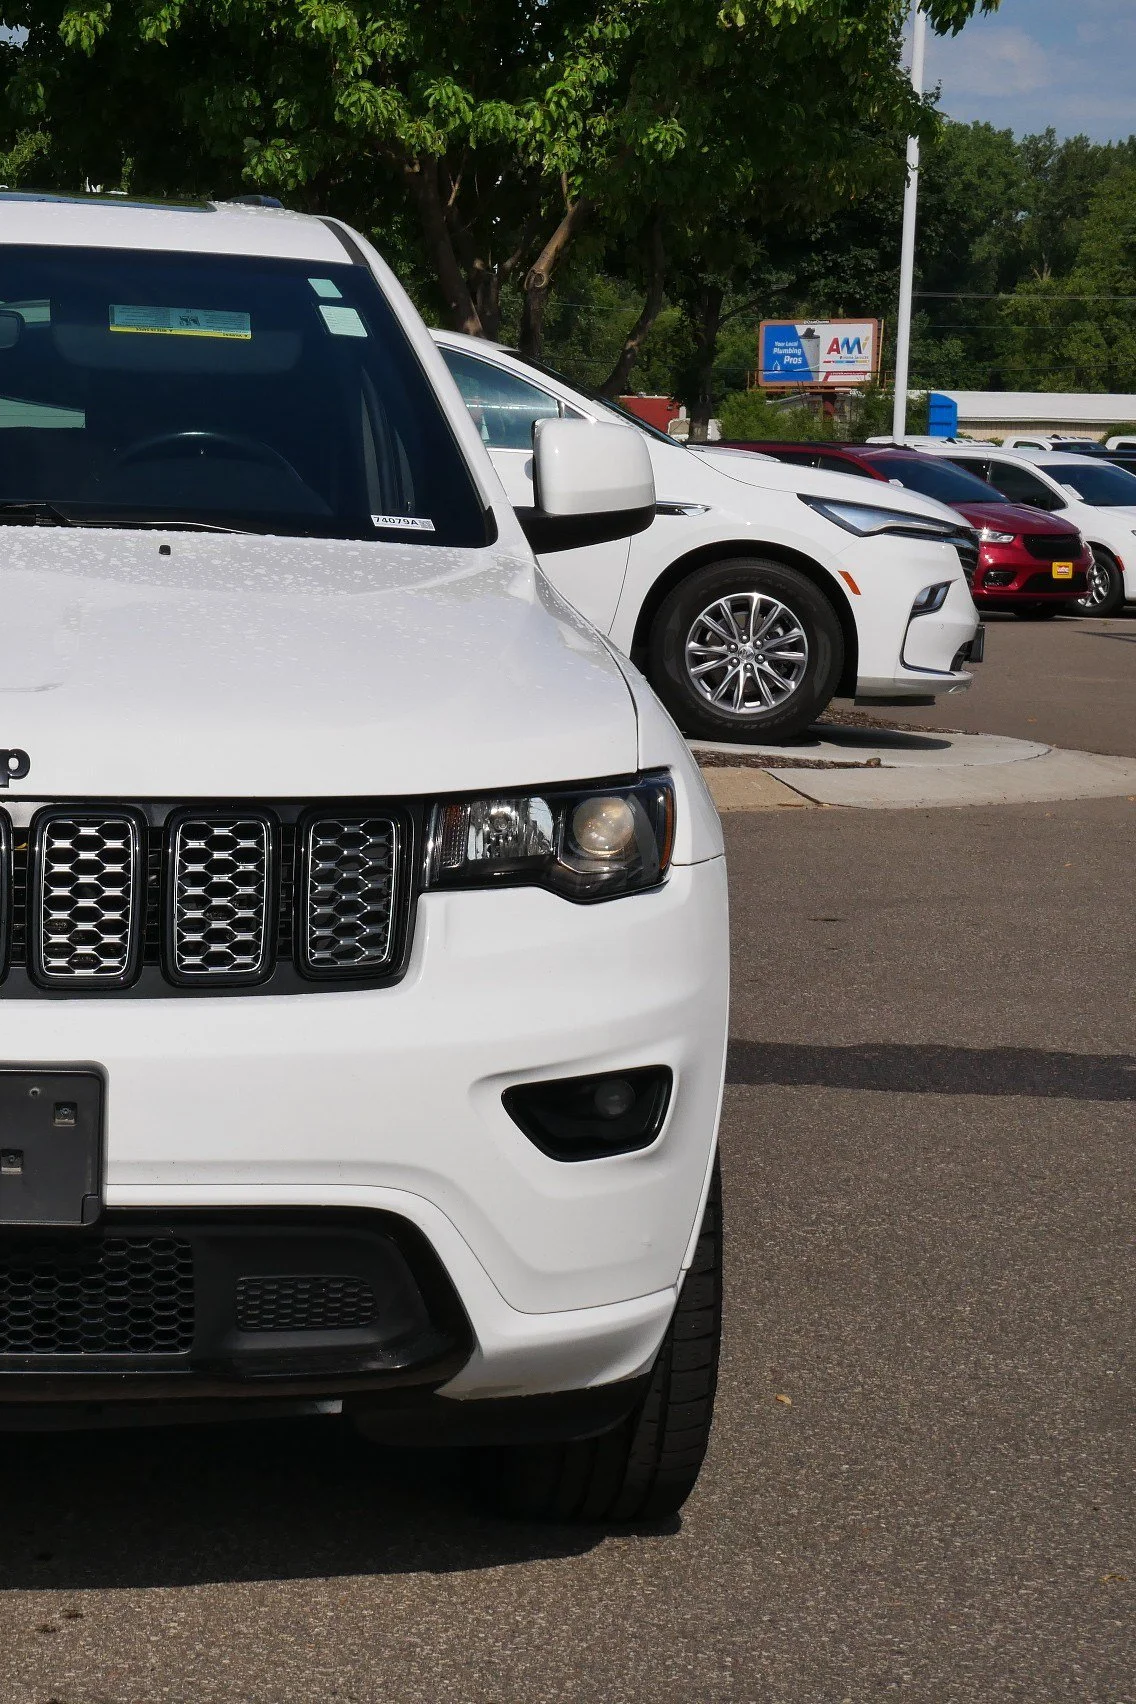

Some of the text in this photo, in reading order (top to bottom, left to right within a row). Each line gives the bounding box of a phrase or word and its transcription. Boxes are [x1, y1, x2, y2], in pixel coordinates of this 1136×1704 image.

[773, 347, 802, 355] Plumbing
[784, 355, 803, 364] Pros
[373, 516, 419, 526] 74079A
